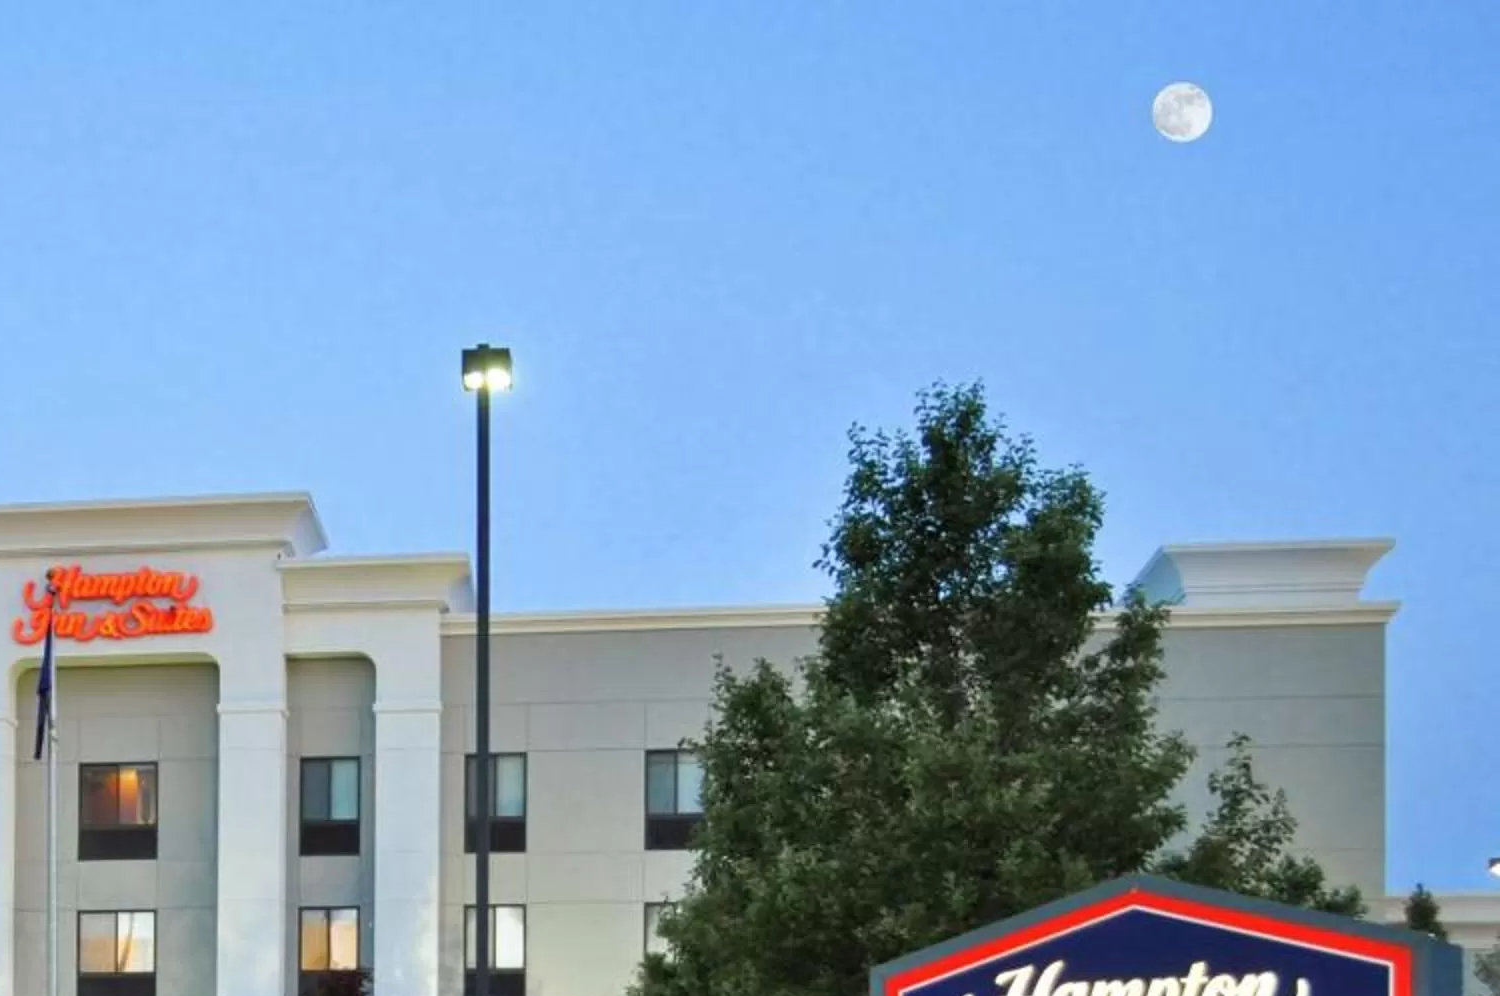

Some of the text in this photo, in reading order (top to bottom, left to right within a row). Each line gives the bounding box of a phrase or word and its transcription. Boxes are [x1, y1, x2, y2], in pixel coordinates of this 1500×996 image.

[23, 564, 199, 609] Hampton
[13, 607, 99, 644] Inn
[118, 600, 215, 635] Suites
